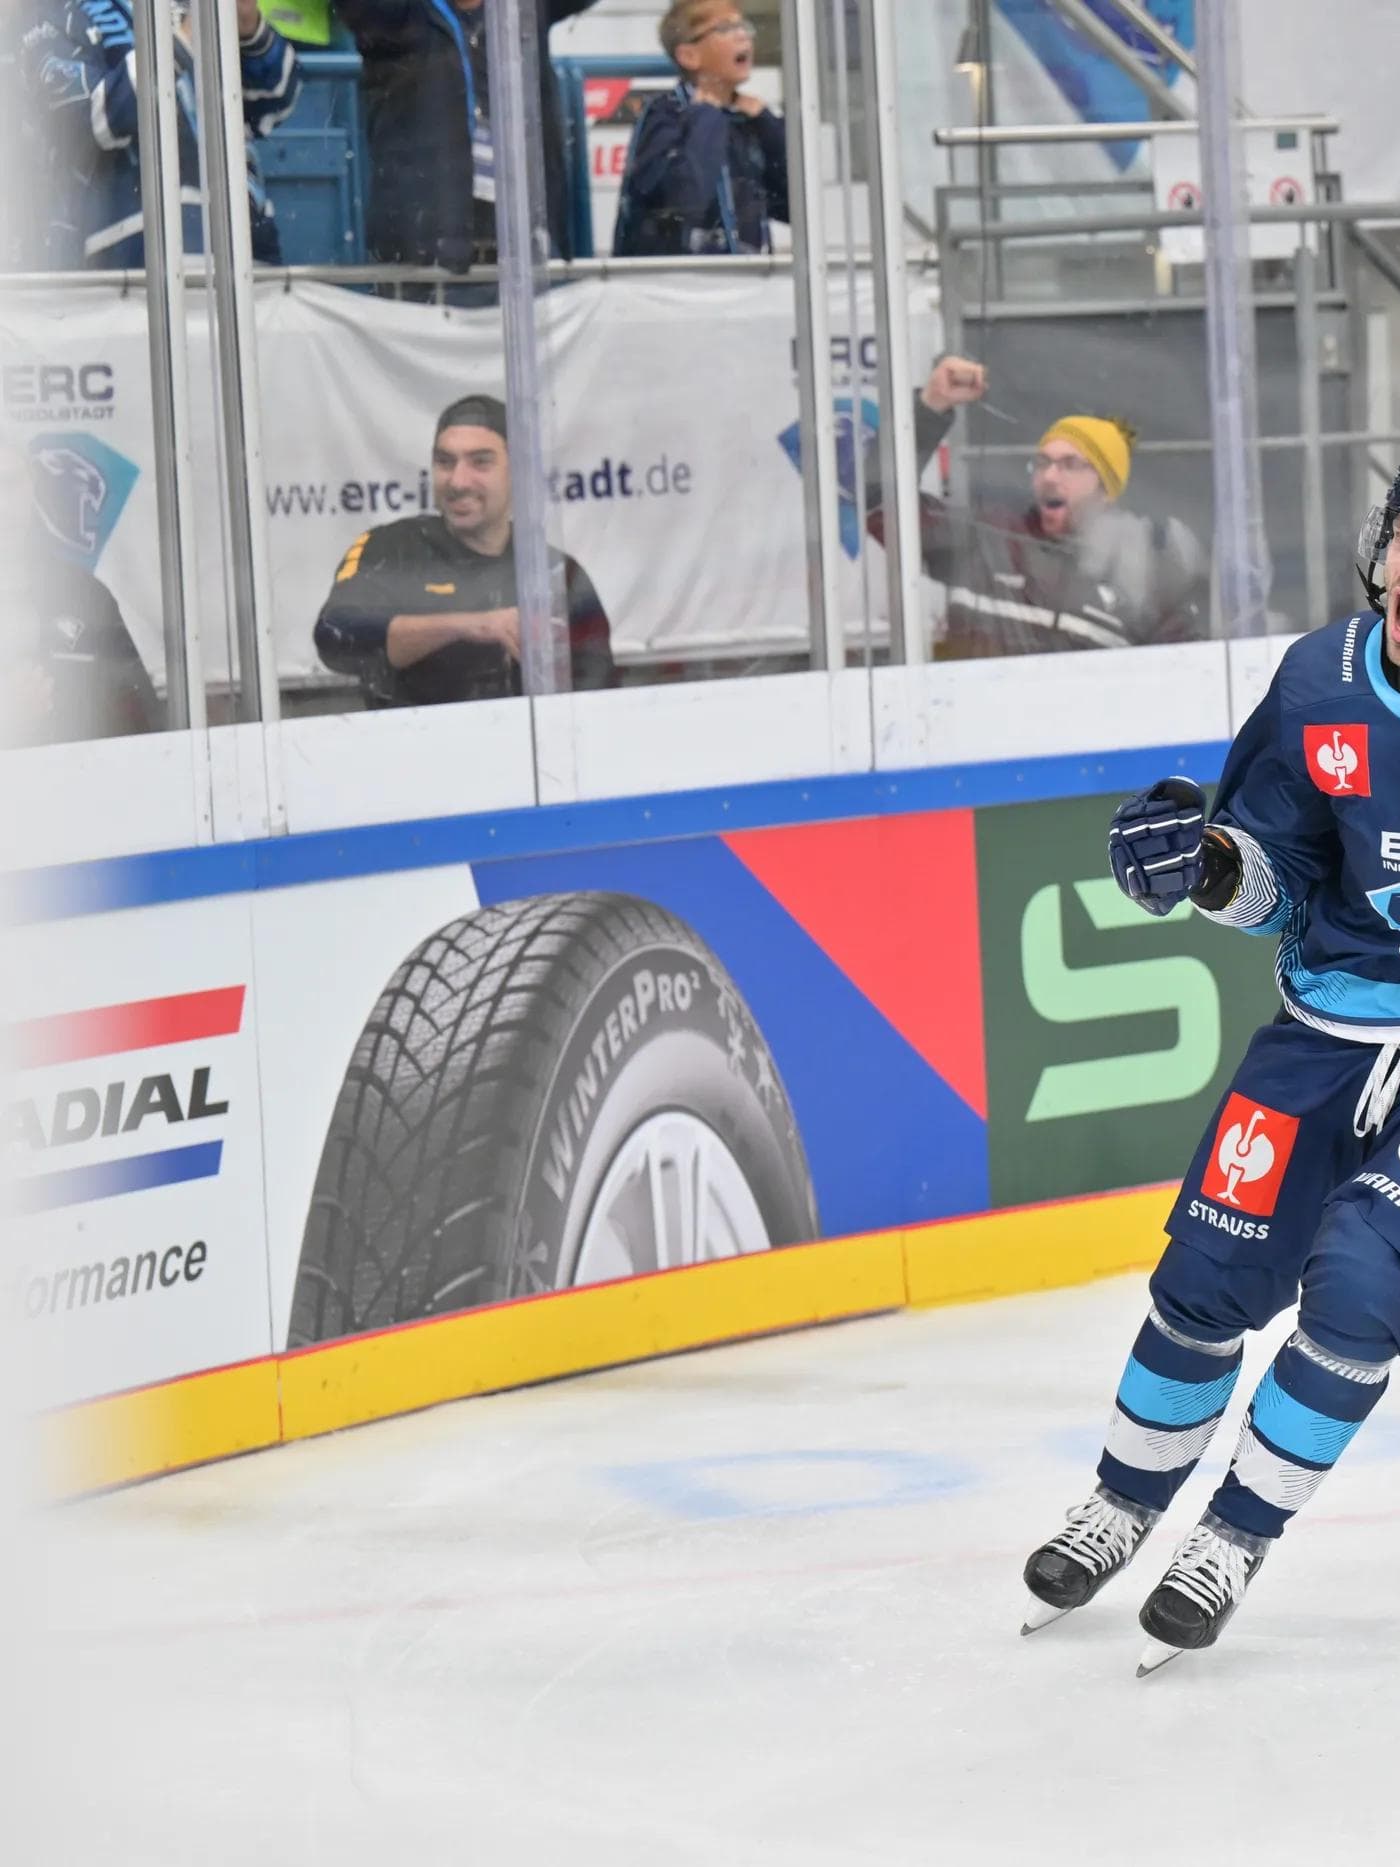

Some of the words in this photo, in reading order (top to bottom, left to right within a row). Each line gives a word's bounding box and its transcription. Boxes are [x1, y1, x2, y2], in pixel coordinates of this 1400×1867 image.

[1342, 617, 1361, 682] WARRIOR
[1187, 1199, 1270, 1240] STRAUSS
[22, 1239, 208, 1320] ormance
